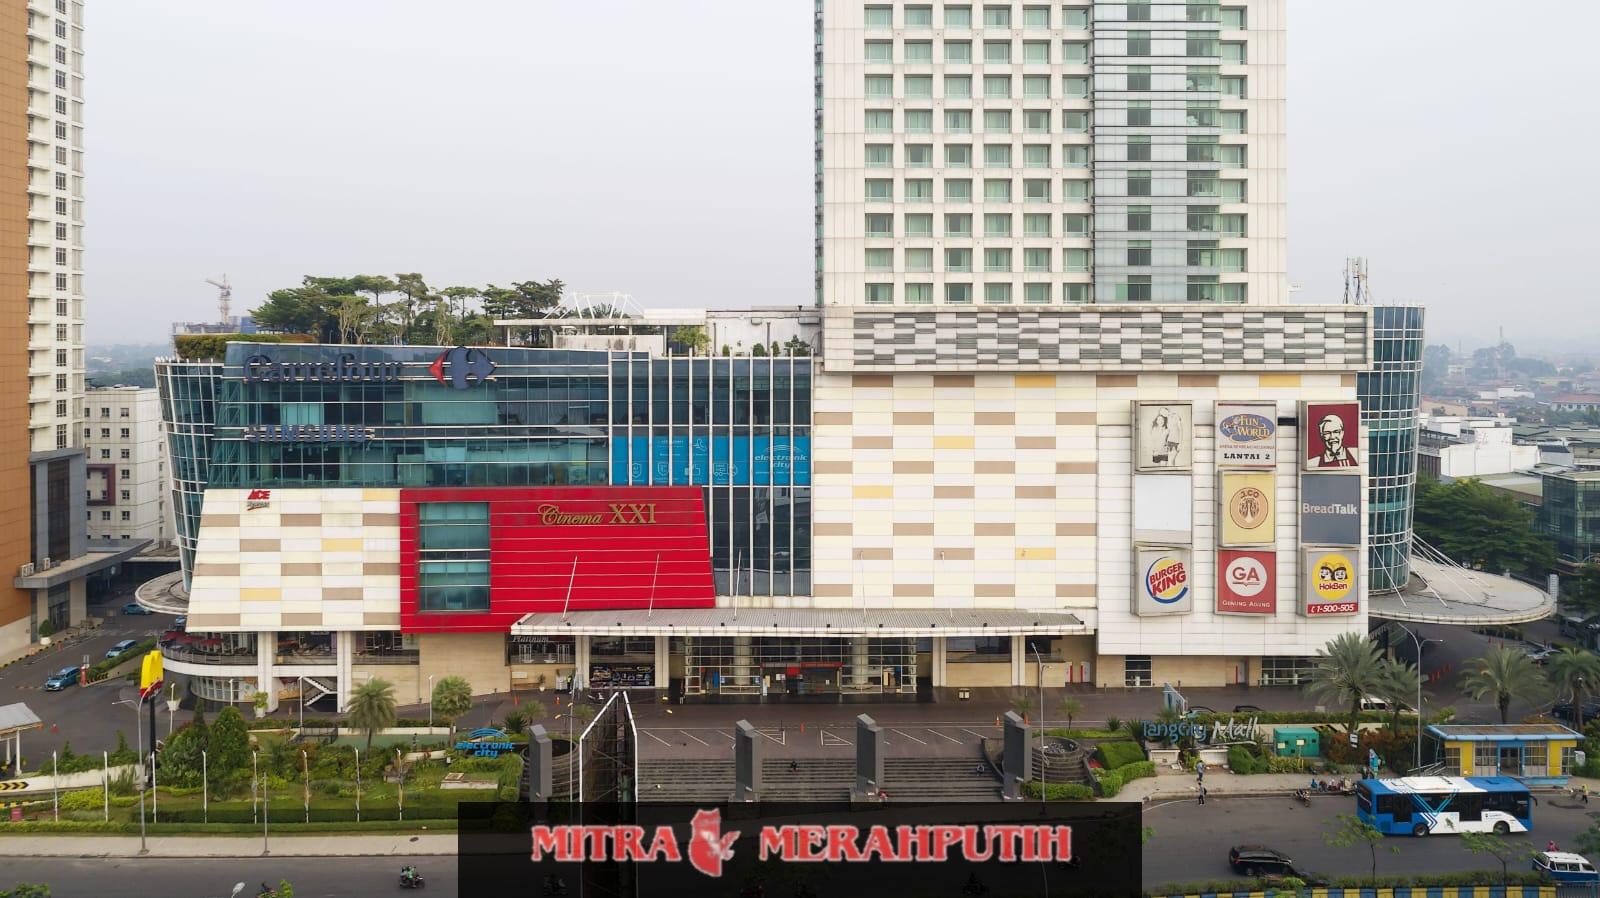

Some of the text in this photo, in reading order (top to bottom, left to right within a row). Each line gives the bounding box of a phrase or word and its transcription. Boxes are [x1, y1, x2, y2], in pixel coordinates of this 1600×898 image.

[243, 354, 402, 383] Carrefour
[1240, 415, 1258, 426] FUN
[248, 423, 368, 443] SAMSUNG
[1238, 427, 1271, 437] WORLD
[247, 489, 271, 500] ACE
[537, 503, 657, 525] Cinema XXI
[1302, 503, 1358, 515] BreadTalk
[1149, 562, 1184, 584] BURGER
[1232, 566, 1261, 582] GA
[1151, 570, 1187, 597] KING
[1317, 604, 1355, 613] 1-500-505
[1212, 716, 1259, 740] Mall
[474, 749, 499, 759] city
